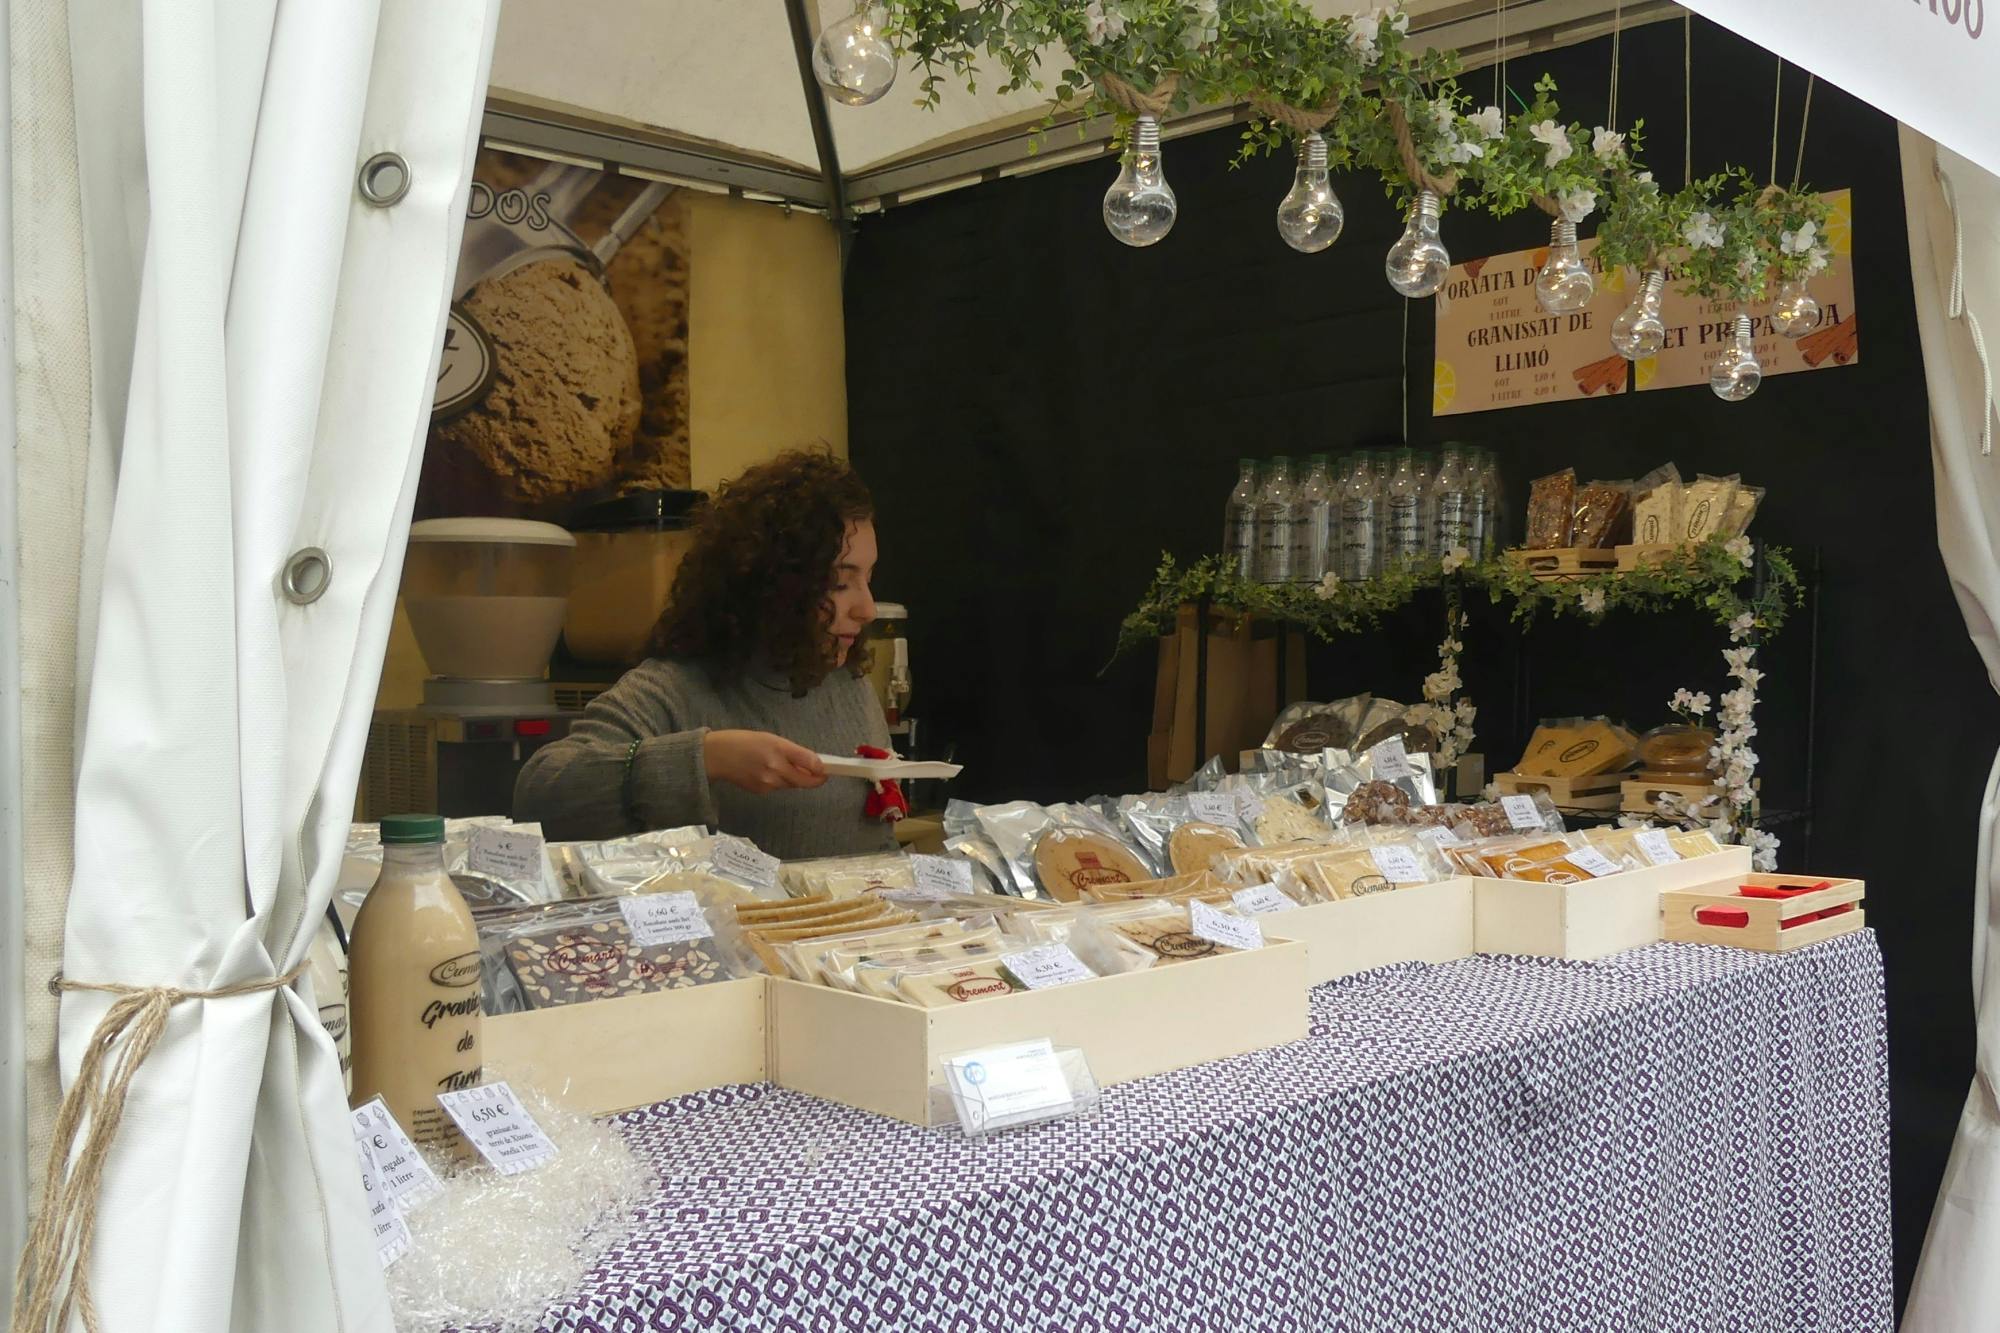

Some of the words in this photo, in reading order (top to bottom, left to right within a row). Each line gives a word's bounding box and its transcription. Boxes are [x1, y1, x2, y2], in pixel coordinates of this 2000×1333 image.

[1468, 316, 1561, 348] GRANISSAT
[1569, 312, 1593, 332] DE
[1495, 345, 1549, 372] LLIMÓ
[669, 906, 678, 915] €
[558, 950, 616, 970] Cremart
[956, 981, 1007, 1000] Cremart
[456, 1029, 475, 1053] de
[472, 1106, 497, 1124] 6,50
[496, 1103, 510, 1116] €
[373, 1134, 388, 1149] €
[362, 1174, 373, 1191] €
[390, 1178, 397, 1188] 1
[397, 1170, 415, 1185] litre
[378, 1220, 392, 1236] litre
